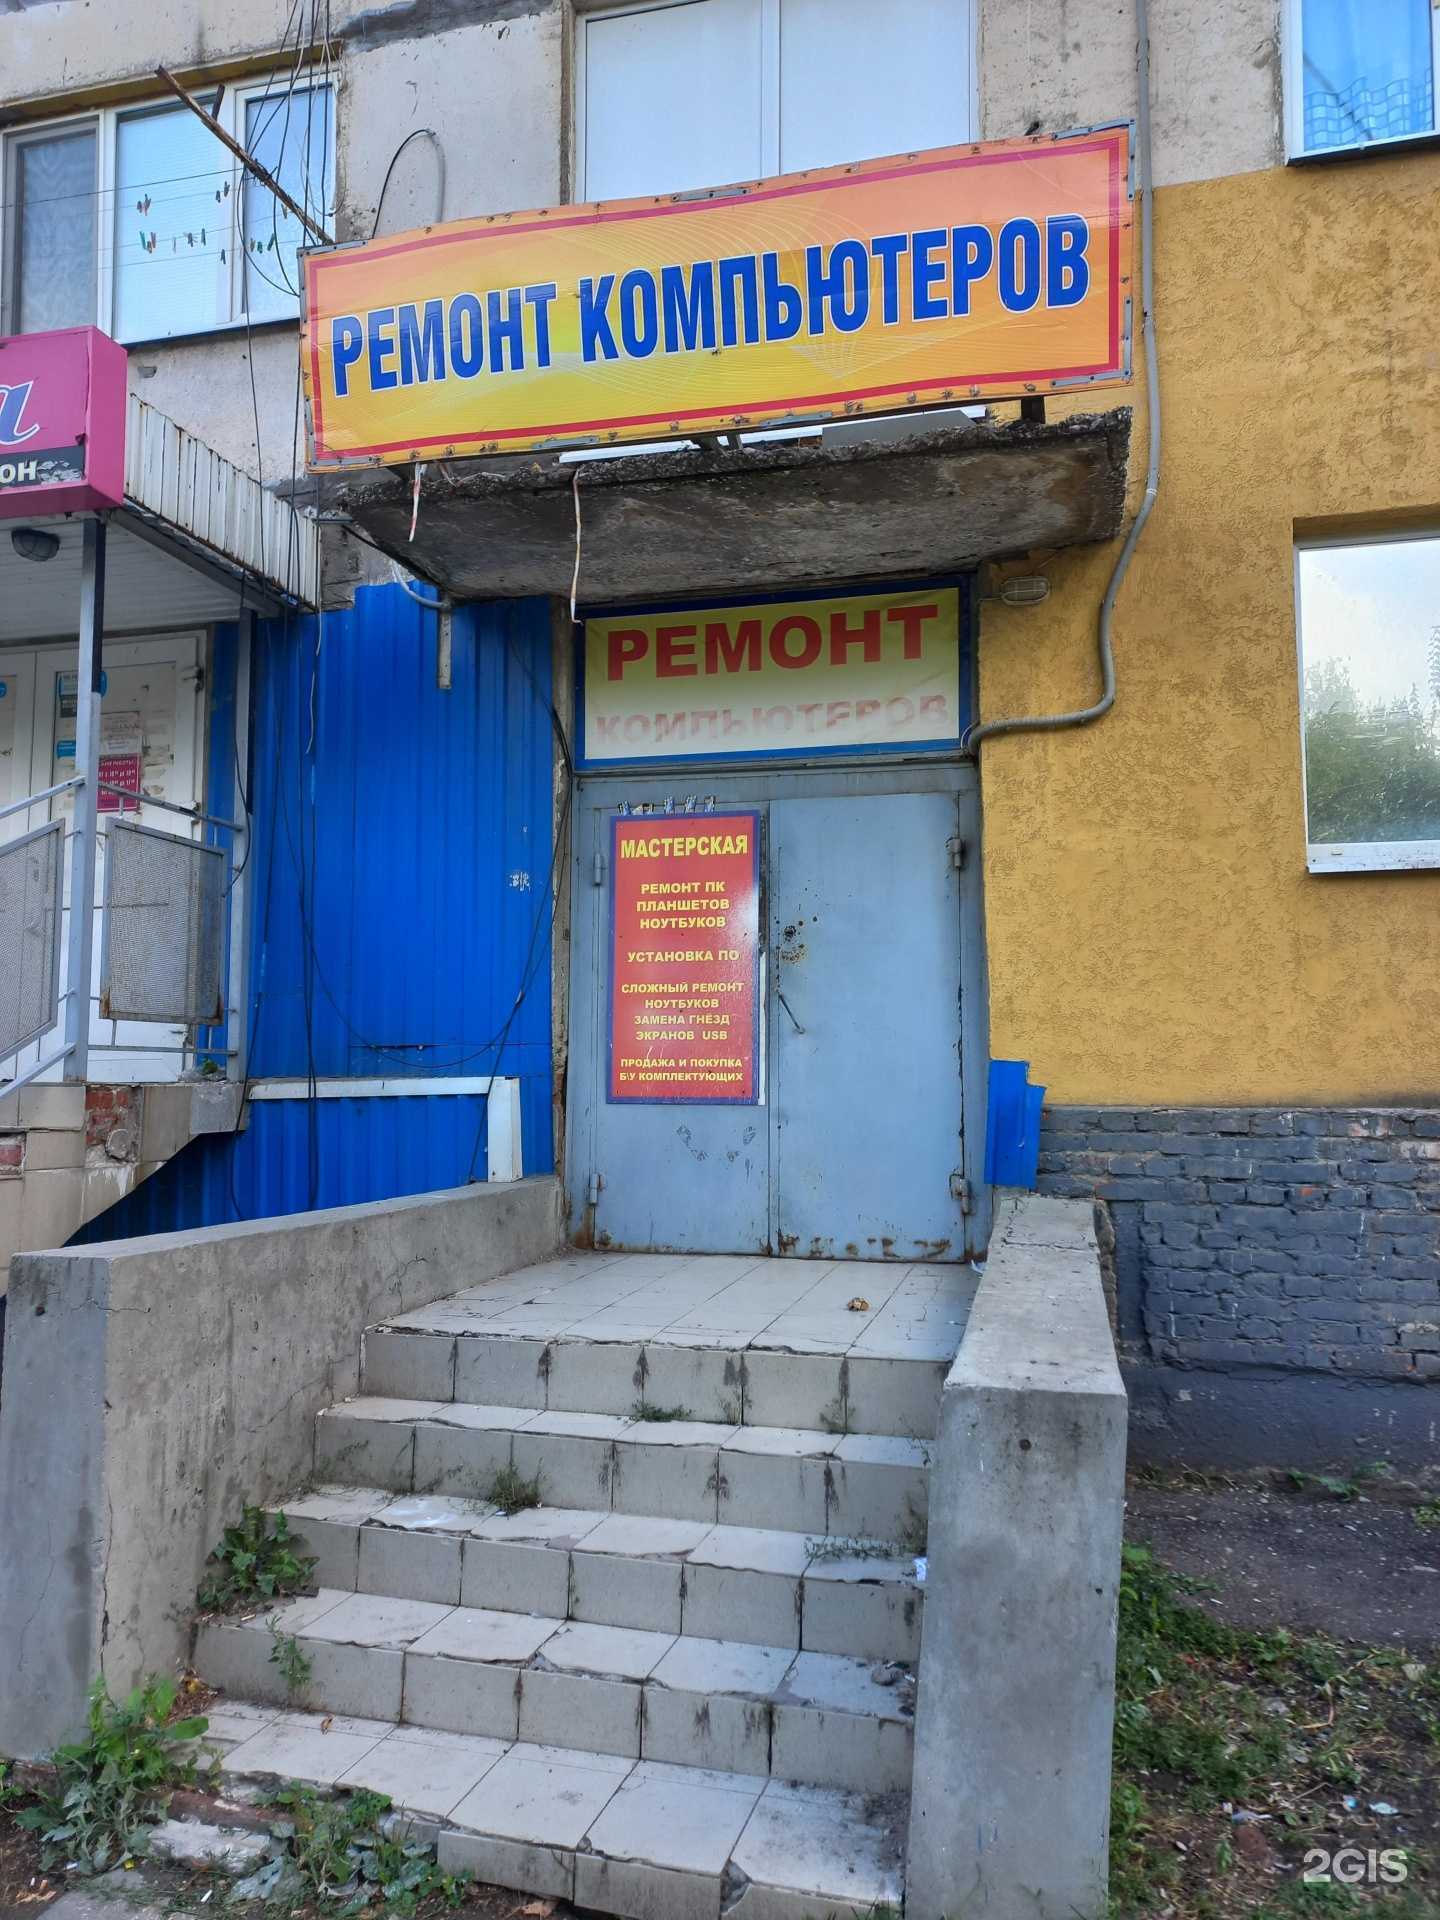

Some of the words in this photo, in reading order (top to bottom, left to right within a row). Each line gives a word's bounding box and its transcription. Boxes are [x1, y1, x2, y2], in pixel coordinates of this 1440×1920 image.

[331, 282, 558, 397] РЕМОНТ
[579, 213, 1091, 363] КОМПЬЮТЕРОВ
[607, 604, 938, 681] РЕМОНТ
[596, 694, 950, 744] КОМПЬЮТЕРОВ
[620, 834, 748, 858] МАСТЕРСКАЯ
[640, 882, 701, 895] РЕМОНТ
[705, 881, 726, 893] ПК
[636, 899, 730, 912] ПЛАНШЕТОВ
[640, 916, 726, 929] НОУТБУКОВ
[628, 950, 714, 963] УСТАНОВКА
[718, 949, 740, 961] ПО
[621, 982, 689, 994] СЛОЖНЫЙ
[692, 982, 745, 993] РЕМОНТ
[645, 999, 720, 1009] НОУТБУКОВ
[634, 1015, 686, 1025] ЗАМЕНА
[635, 1031, 695, 1041] ЭКРАНОВ
[702, 1030, 728, 1041] USB
[620, 1058, 675, 1068] ПРОДАЖА
[679, 1058, 687, 1067] И
[690, 1058, 743, 1068] ПОКУПКА
[638, 1072, 744, 1082] КОМПЛЕКТУЮЩИХ
